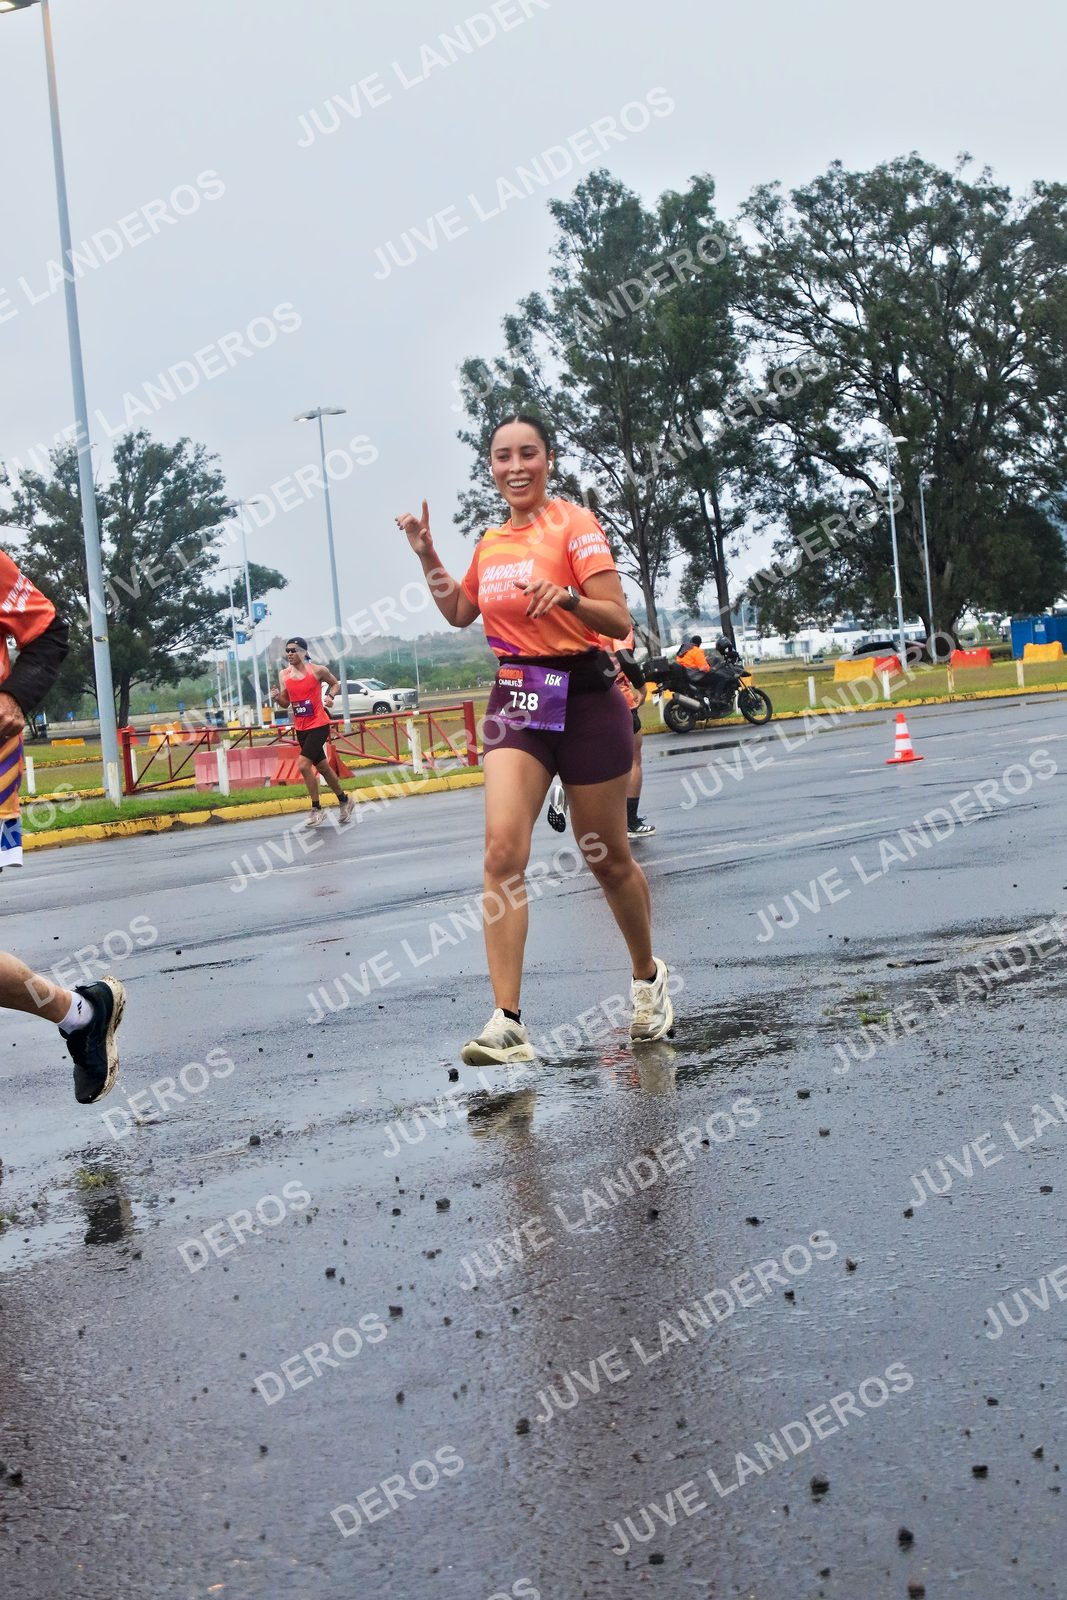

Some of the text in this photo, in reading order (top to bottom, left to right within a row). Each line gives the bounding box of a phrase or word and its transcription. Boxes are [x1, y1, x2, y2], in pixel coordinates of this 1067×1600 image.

[480, 558, 534, 583] CARRERA
[544, 673, 562, 687] 16K
[509, 690, 539, 711] 728
